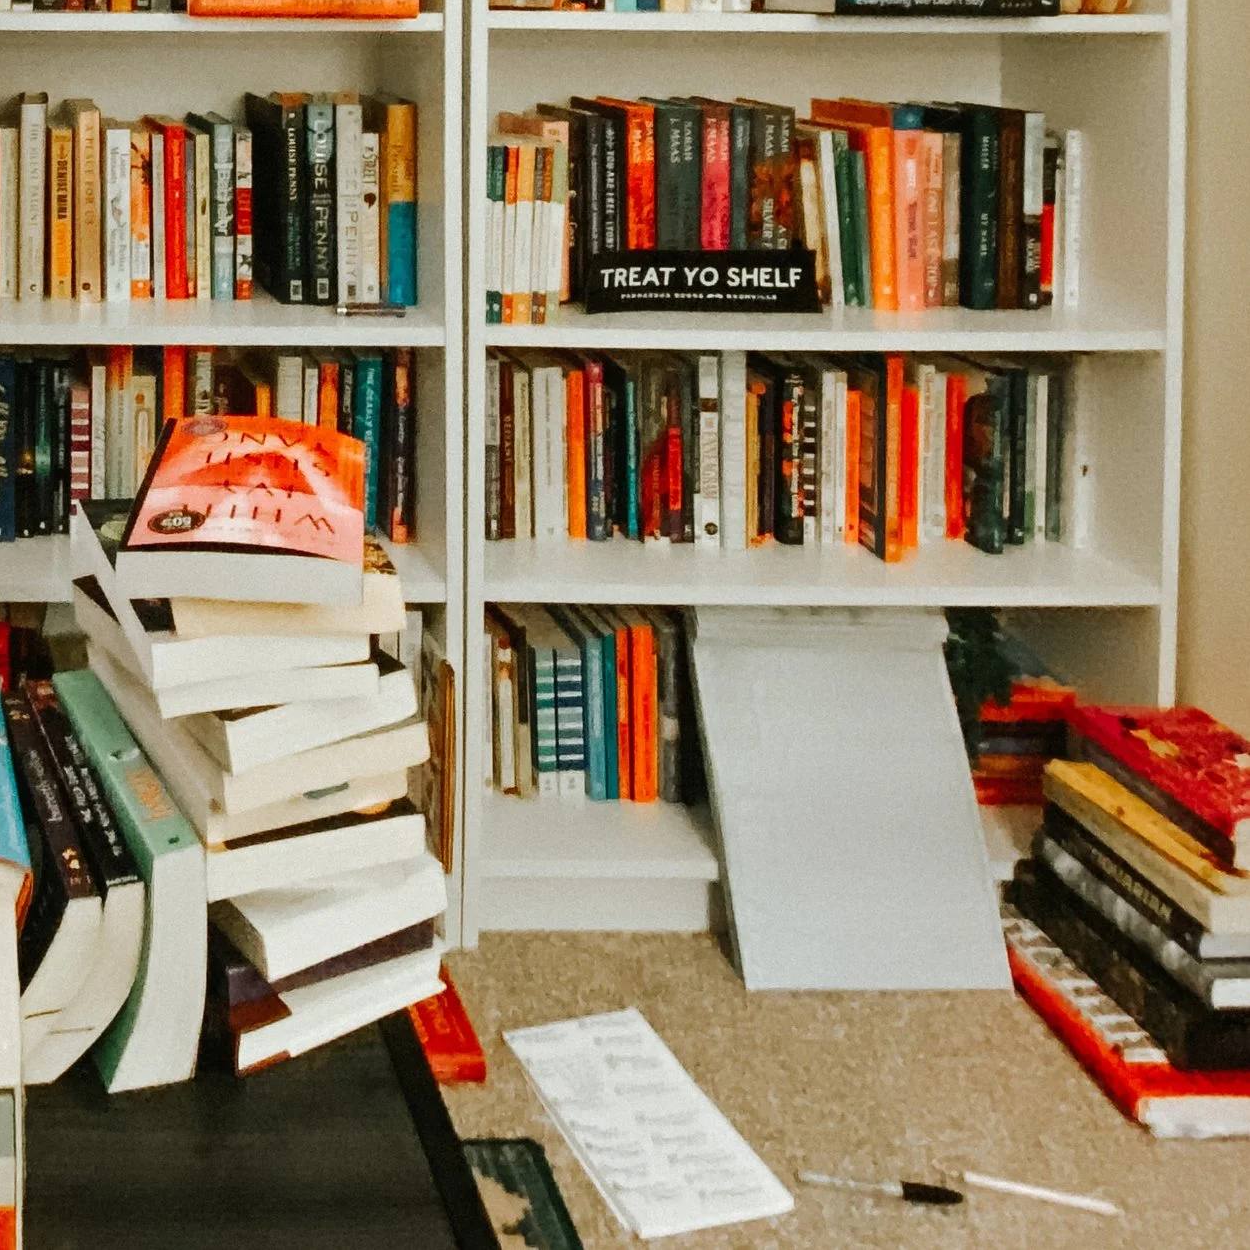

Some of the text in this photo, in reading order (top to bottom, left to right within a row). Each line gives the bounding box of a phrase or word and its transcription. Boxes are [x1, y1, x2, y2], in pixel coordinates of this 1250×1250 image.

[670, 129, 681, 164] MAAS
[684, 121, 693, 162] SARAH
[765, 124, 775, 158] MAAS
[287, 127, 298, 201] LOUISE PENNY
[57, 160, 68, 220] DENISE MINA
[314, 119, 329, 271] LOUISE PENNY
[763, 197, 774, 238] SILVER
[600, 267, 802, 288] TREAT YO SHELF
